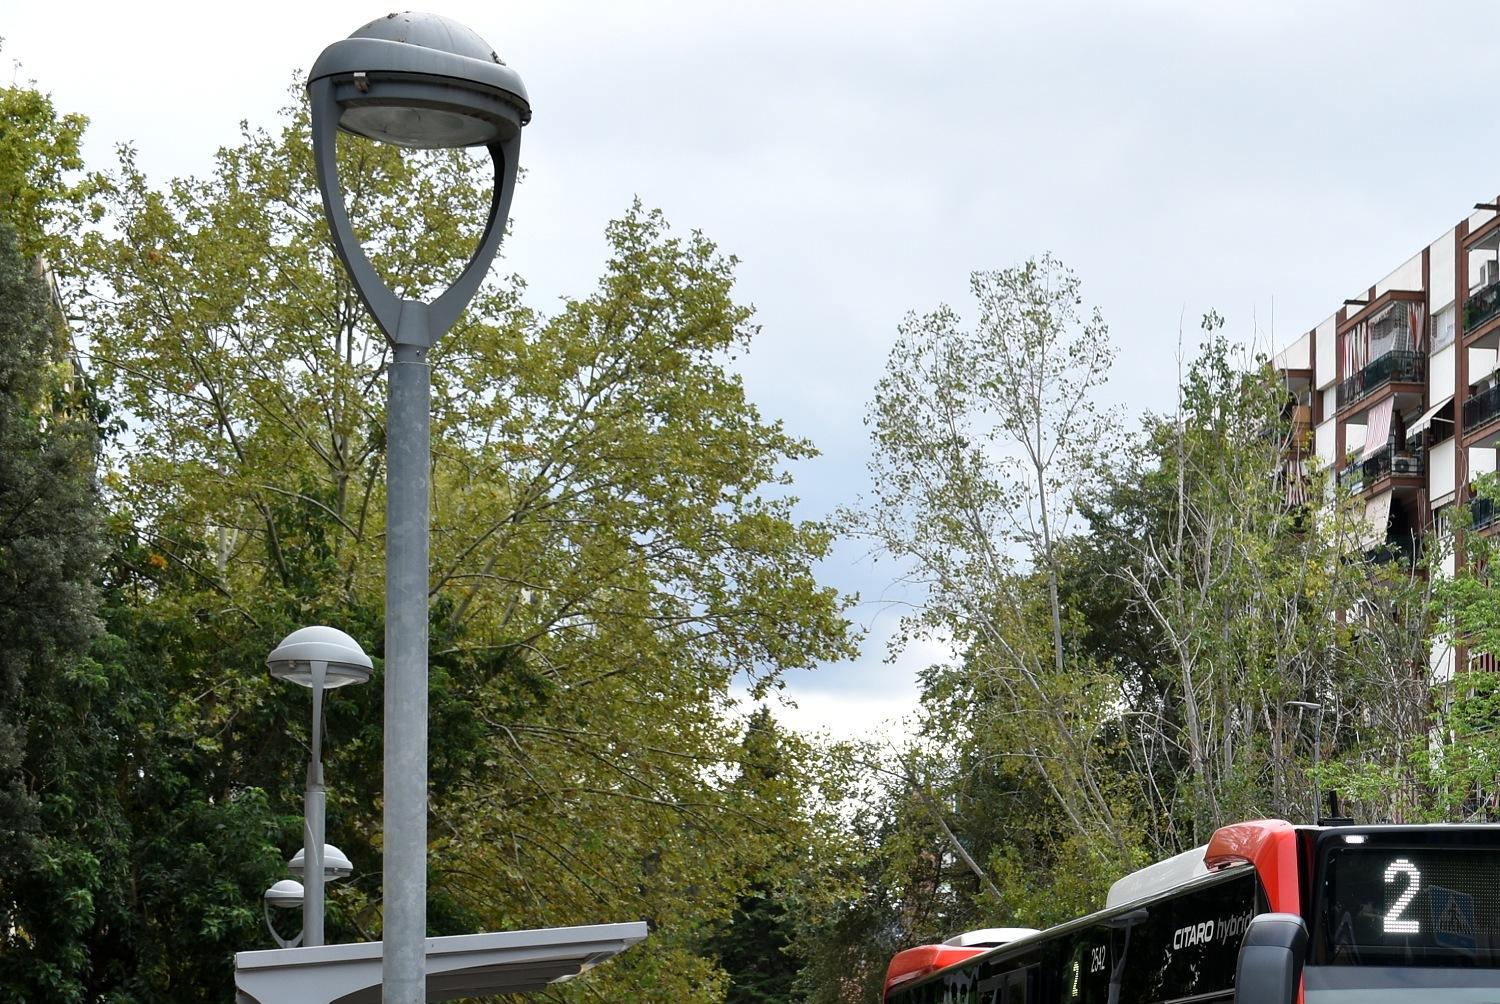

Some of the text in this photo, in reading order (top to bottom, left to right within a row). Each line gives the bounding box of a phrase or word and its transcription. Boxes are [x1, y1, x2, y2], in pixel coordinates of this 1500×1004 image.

[1384, 859, 1420, 933] 2
[1173, 919, 1215, 951] CITARO
[1090, 945, 1106, 973] 2542
